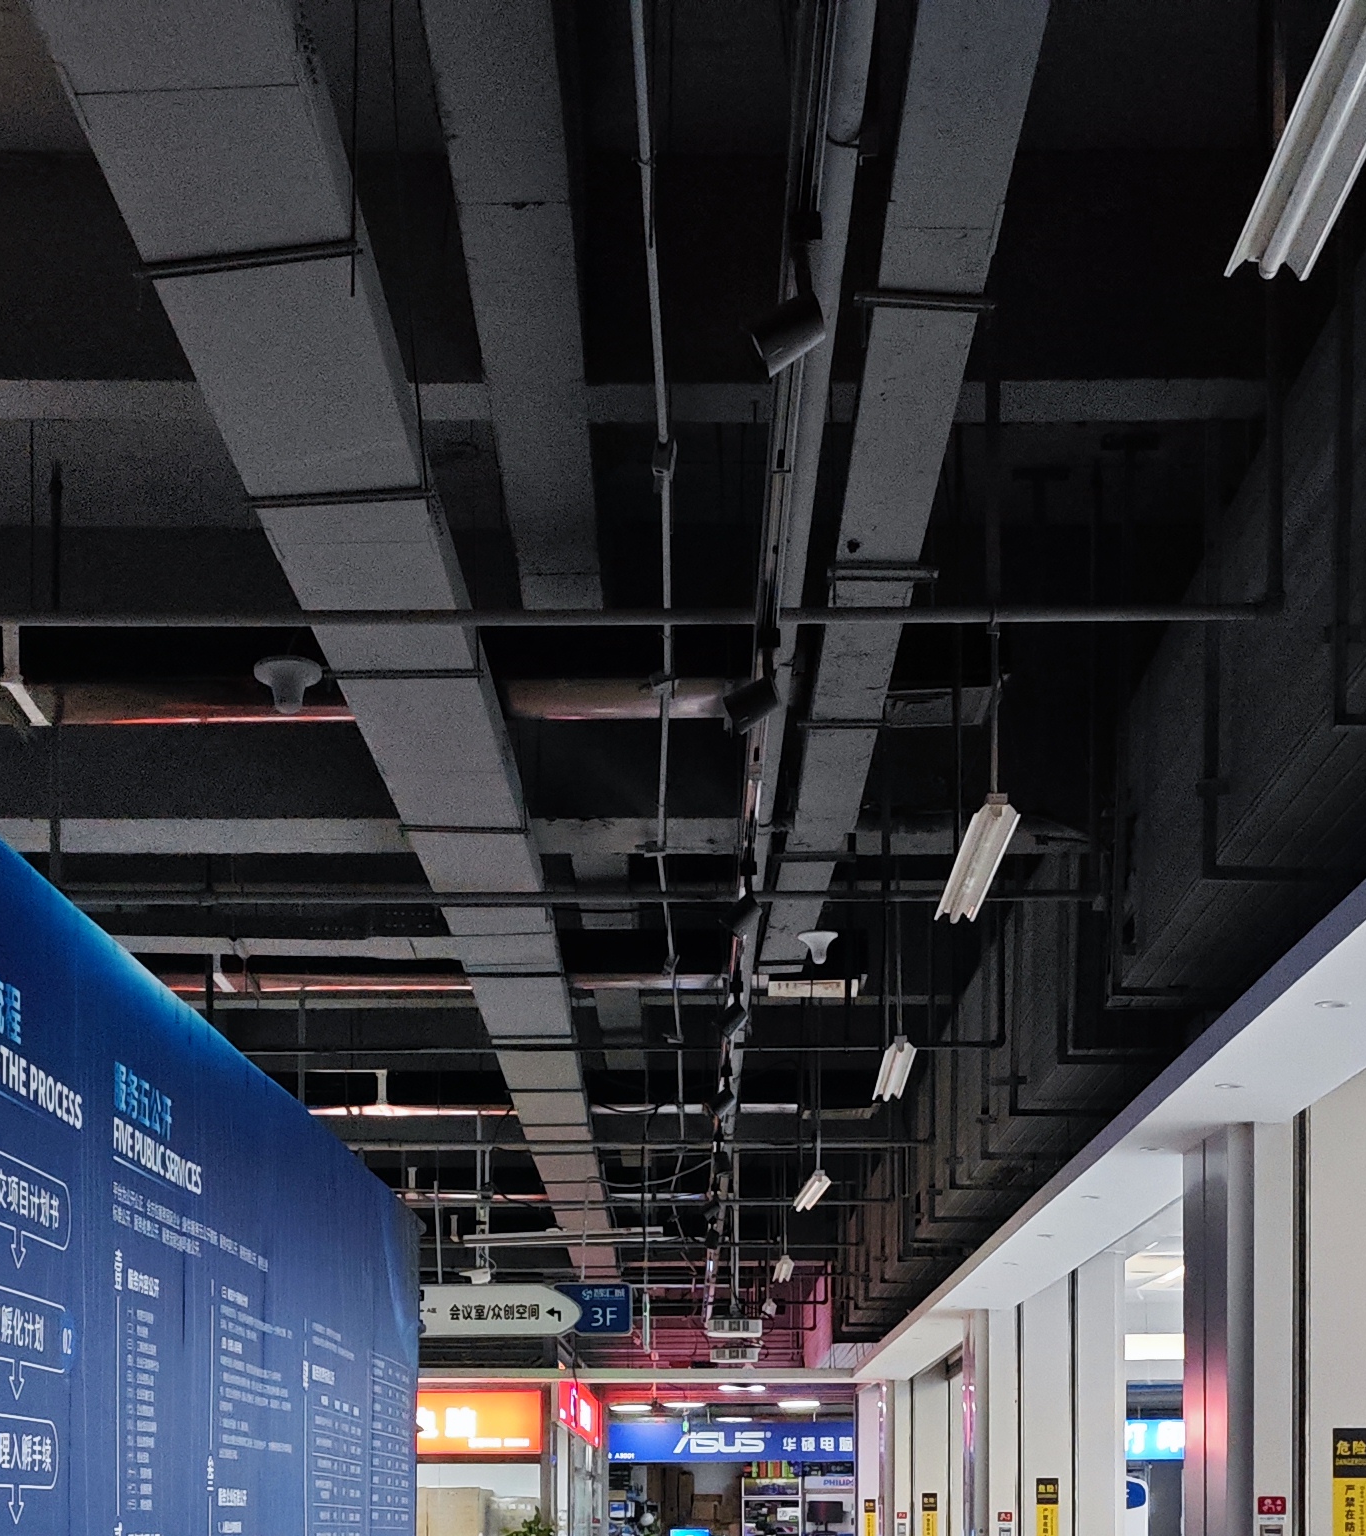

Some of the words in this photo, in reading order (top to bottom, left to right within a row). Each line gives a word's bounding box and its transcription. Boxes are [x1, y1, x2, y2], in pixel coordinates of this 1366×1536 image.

[0, 1045, 27, 1097] THE
[29, 1063, 83, 1130] PROCESS
[113, 1116, 134, 1158] FIVE
[134, 1129, 165, 1177] PUBLIC
[449, 1304, 541, 1321] 会议室/众创空间
[590, 1307, 619, 1327] 3F
[62, 1327, 72, 1355] 02
[672, 1431, 766, 1454] ASUS
[782, 1436, 854, 1452] 华硕电脑
